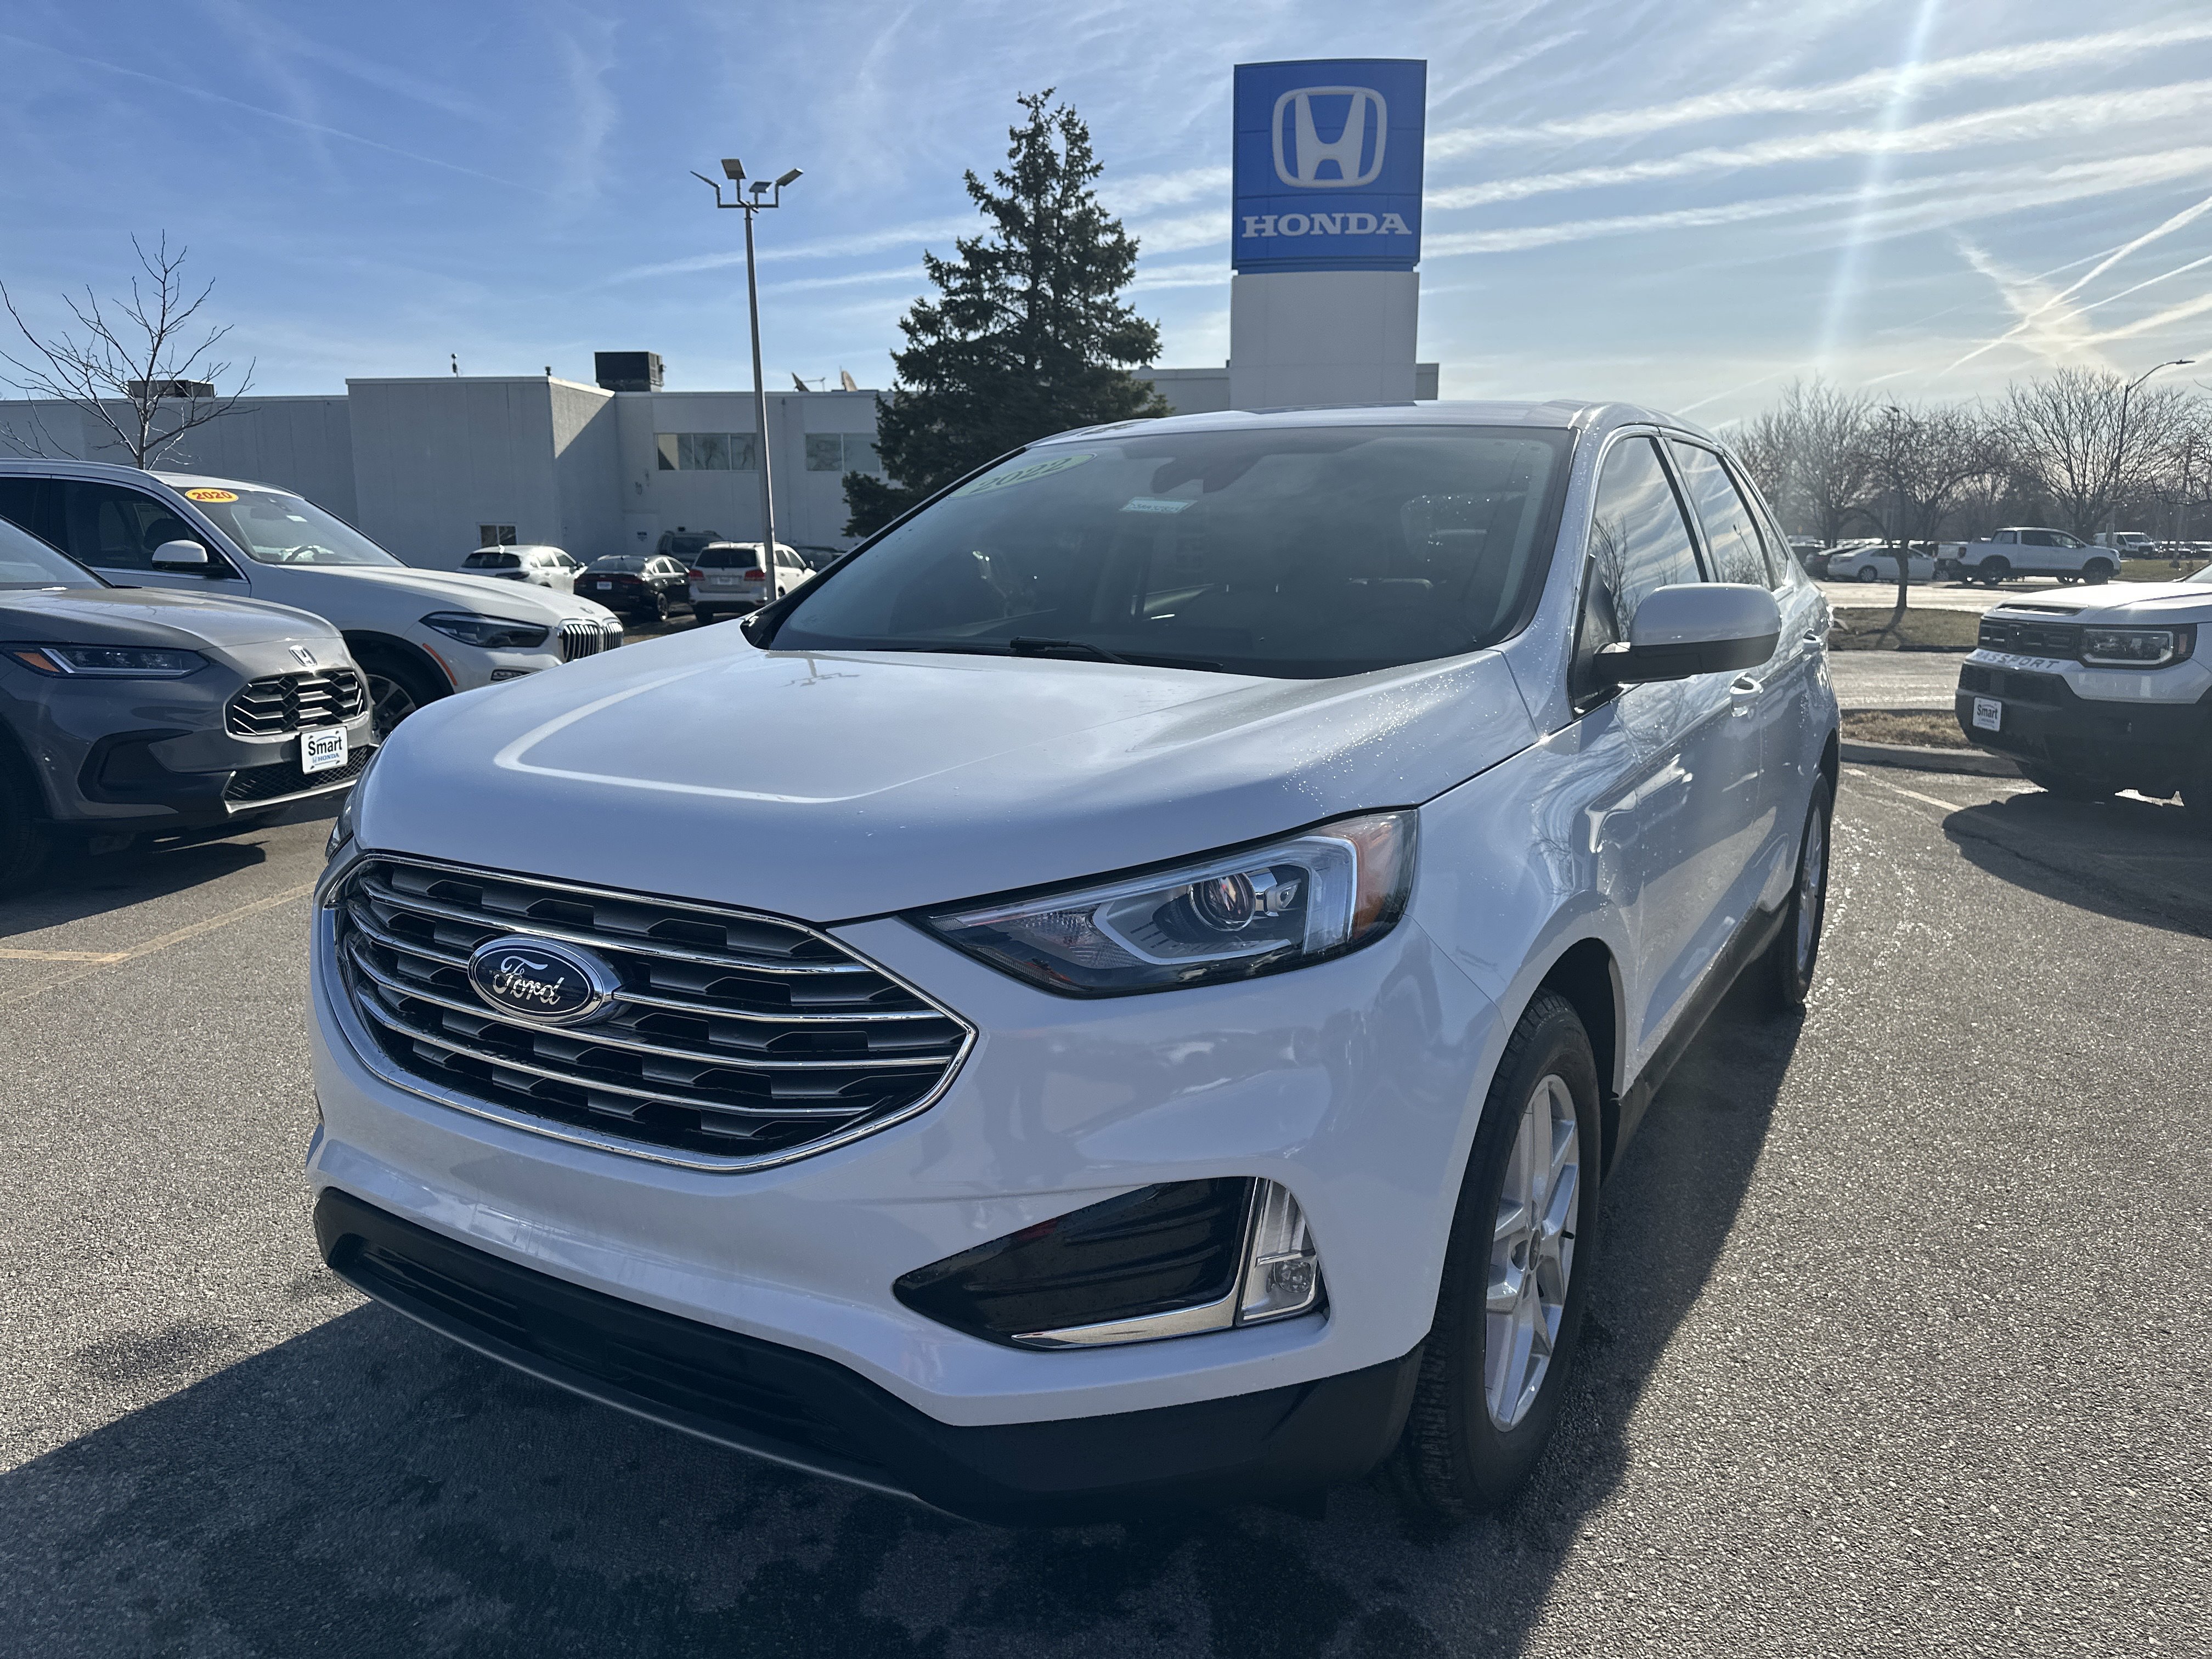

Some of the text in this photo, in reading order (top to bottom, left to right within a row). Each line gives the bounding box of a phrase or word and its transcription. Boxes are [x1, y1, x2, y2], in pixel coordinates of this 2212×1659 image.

[1242, 213, 1412, 238] HONDA
[968, 458, 1072, 494] 2022
[192, 492, 233, 500] 2020
[1977, 704, 1998, 719] Smart
[308, 736, 342, 756] Smart
[318, 753, 339, 761] HONDA
[492, 955, 565, 1005] Ford
